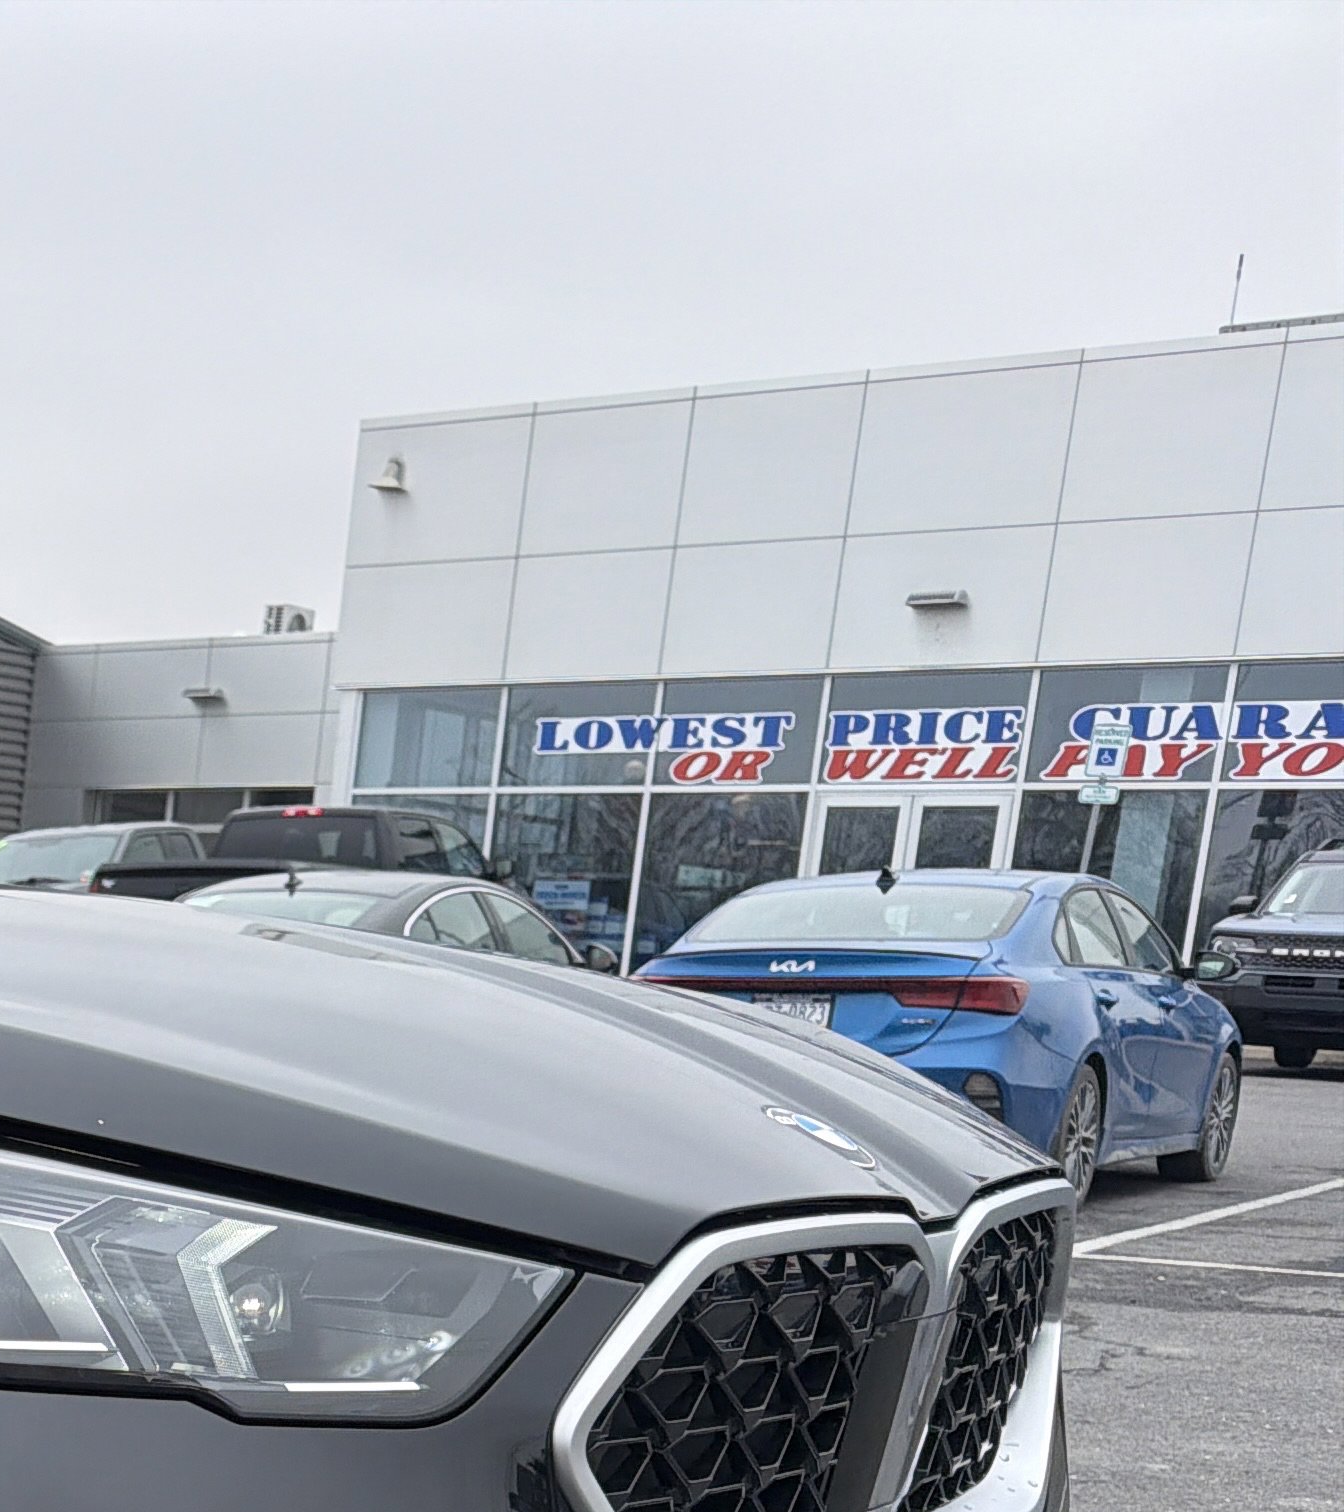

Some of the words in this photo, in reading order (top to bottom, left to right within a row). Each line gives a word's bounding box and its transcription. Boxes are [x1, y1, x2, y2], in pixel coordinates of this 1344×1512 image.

[536, 714, 793, 751] LOWEST
[829, 709, 1023, 746] PRICE
[672, 751, 771, 781] OR
[826, 746, 1016, 780] WE'LL
[768, 959, 816, 973] KIA
